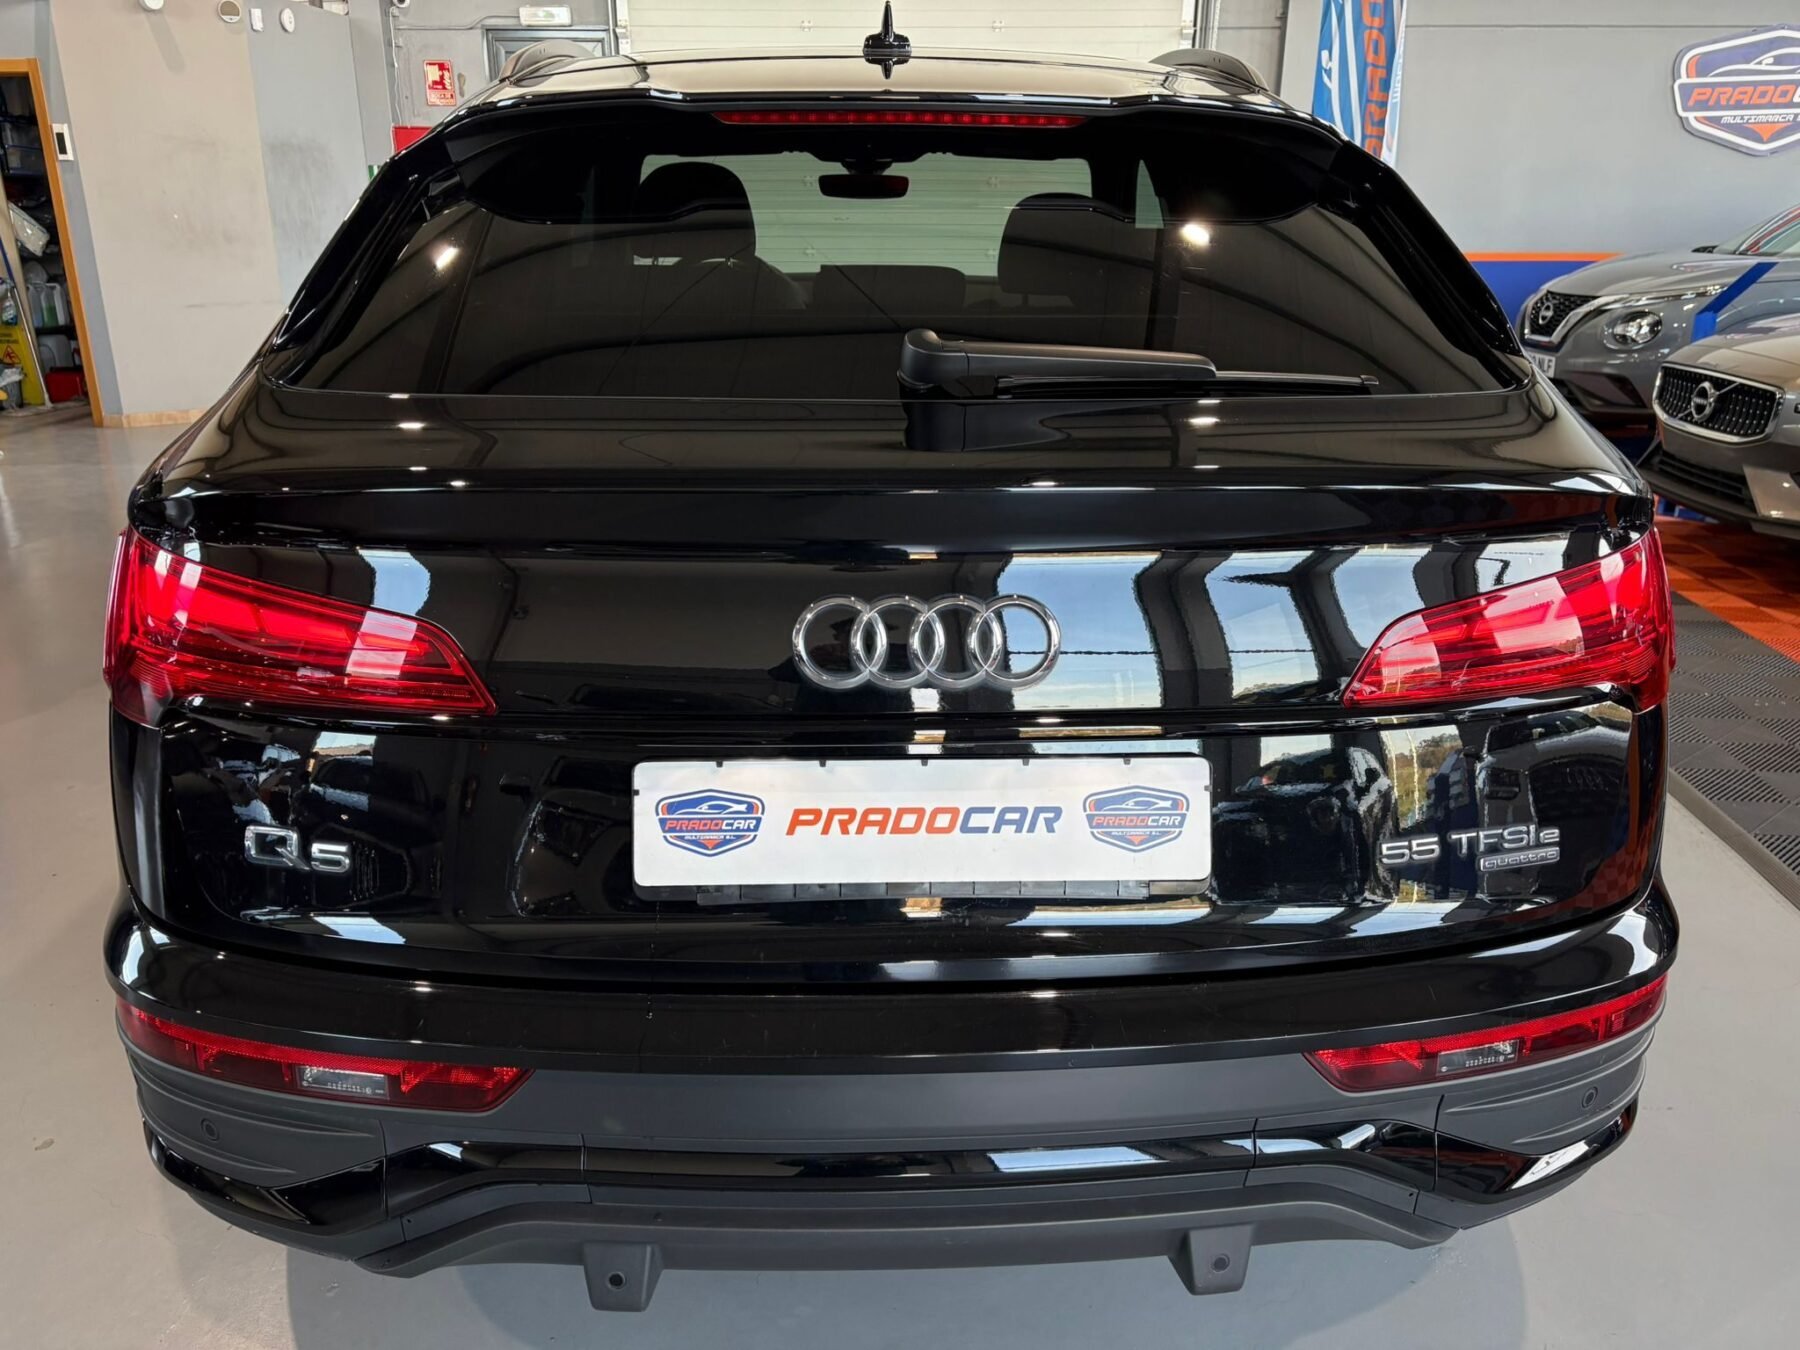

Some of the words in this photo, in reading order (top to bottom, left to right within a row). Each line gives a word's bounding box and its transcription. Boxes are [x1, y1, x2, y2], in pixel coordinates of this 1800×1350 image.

[1720, 114, 1794, 124] MULTIMARCA
[665, 820, 756, 831] PRADOCAR
[785, 806, 1063, 836] PRADOCAR
[1092, 816, 1181, 826] PRADOCAR
[244, 825, 350, 873] Q5
[1381, 836, 1440, 864] 55
[1485, 851, 1557, 869] quattro
